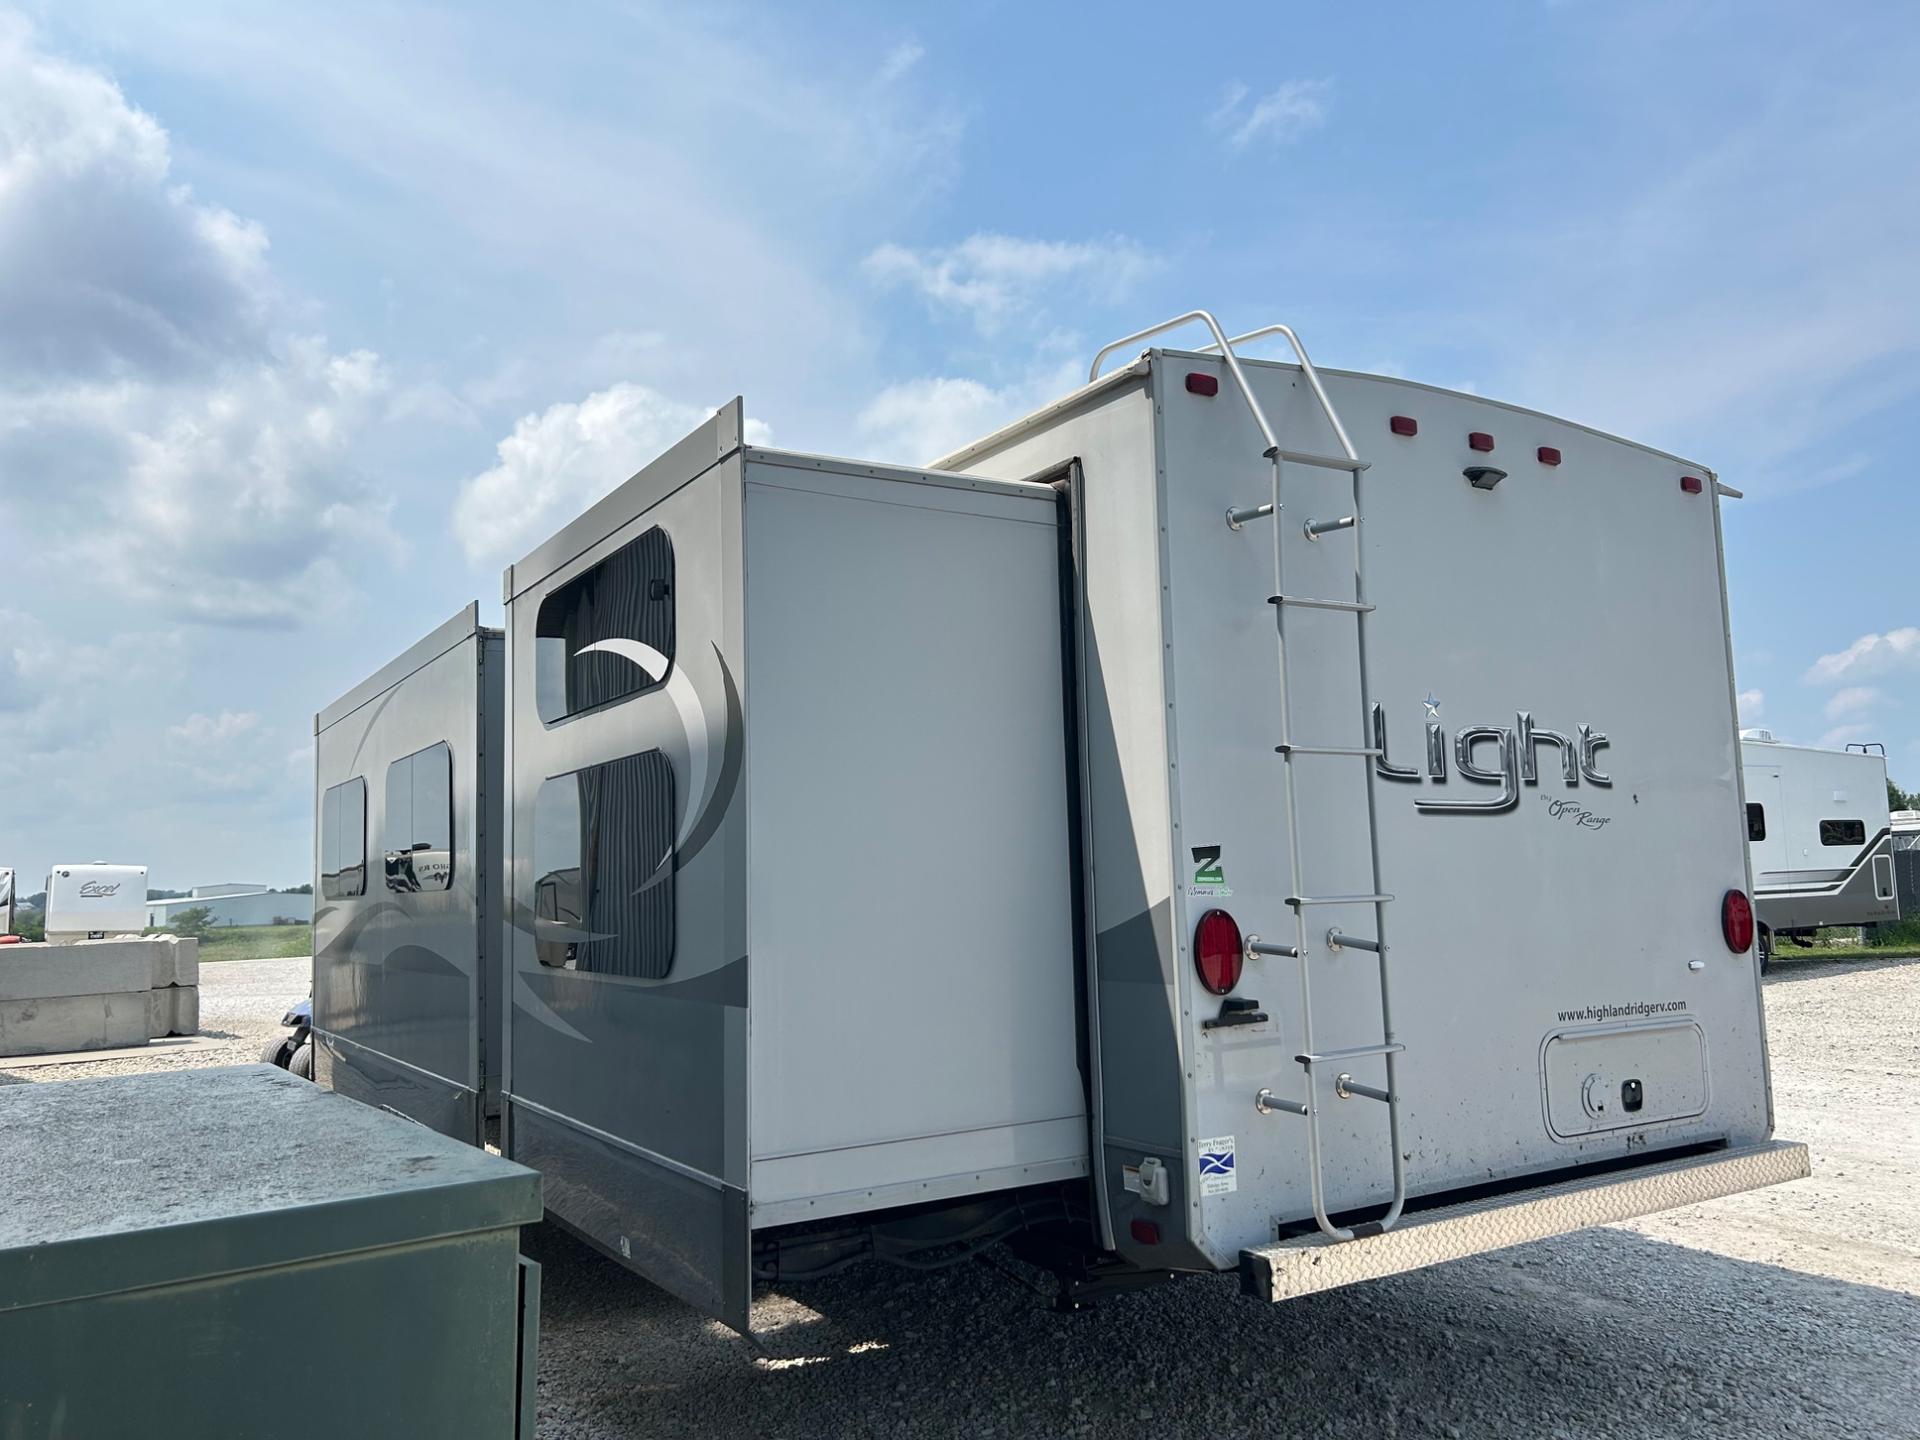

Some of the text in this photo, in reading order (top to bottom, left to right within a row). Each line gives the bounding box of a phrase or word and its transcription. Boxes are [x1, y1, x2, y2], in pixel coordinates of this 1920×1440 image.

[1372, 694, 1611, 808] Light
[1548, 800, 1581, 820] Open
[1573, 811, 1611, 830] Range
[1557, 1000, 1687, 1022] www.highlandridgerv.com
